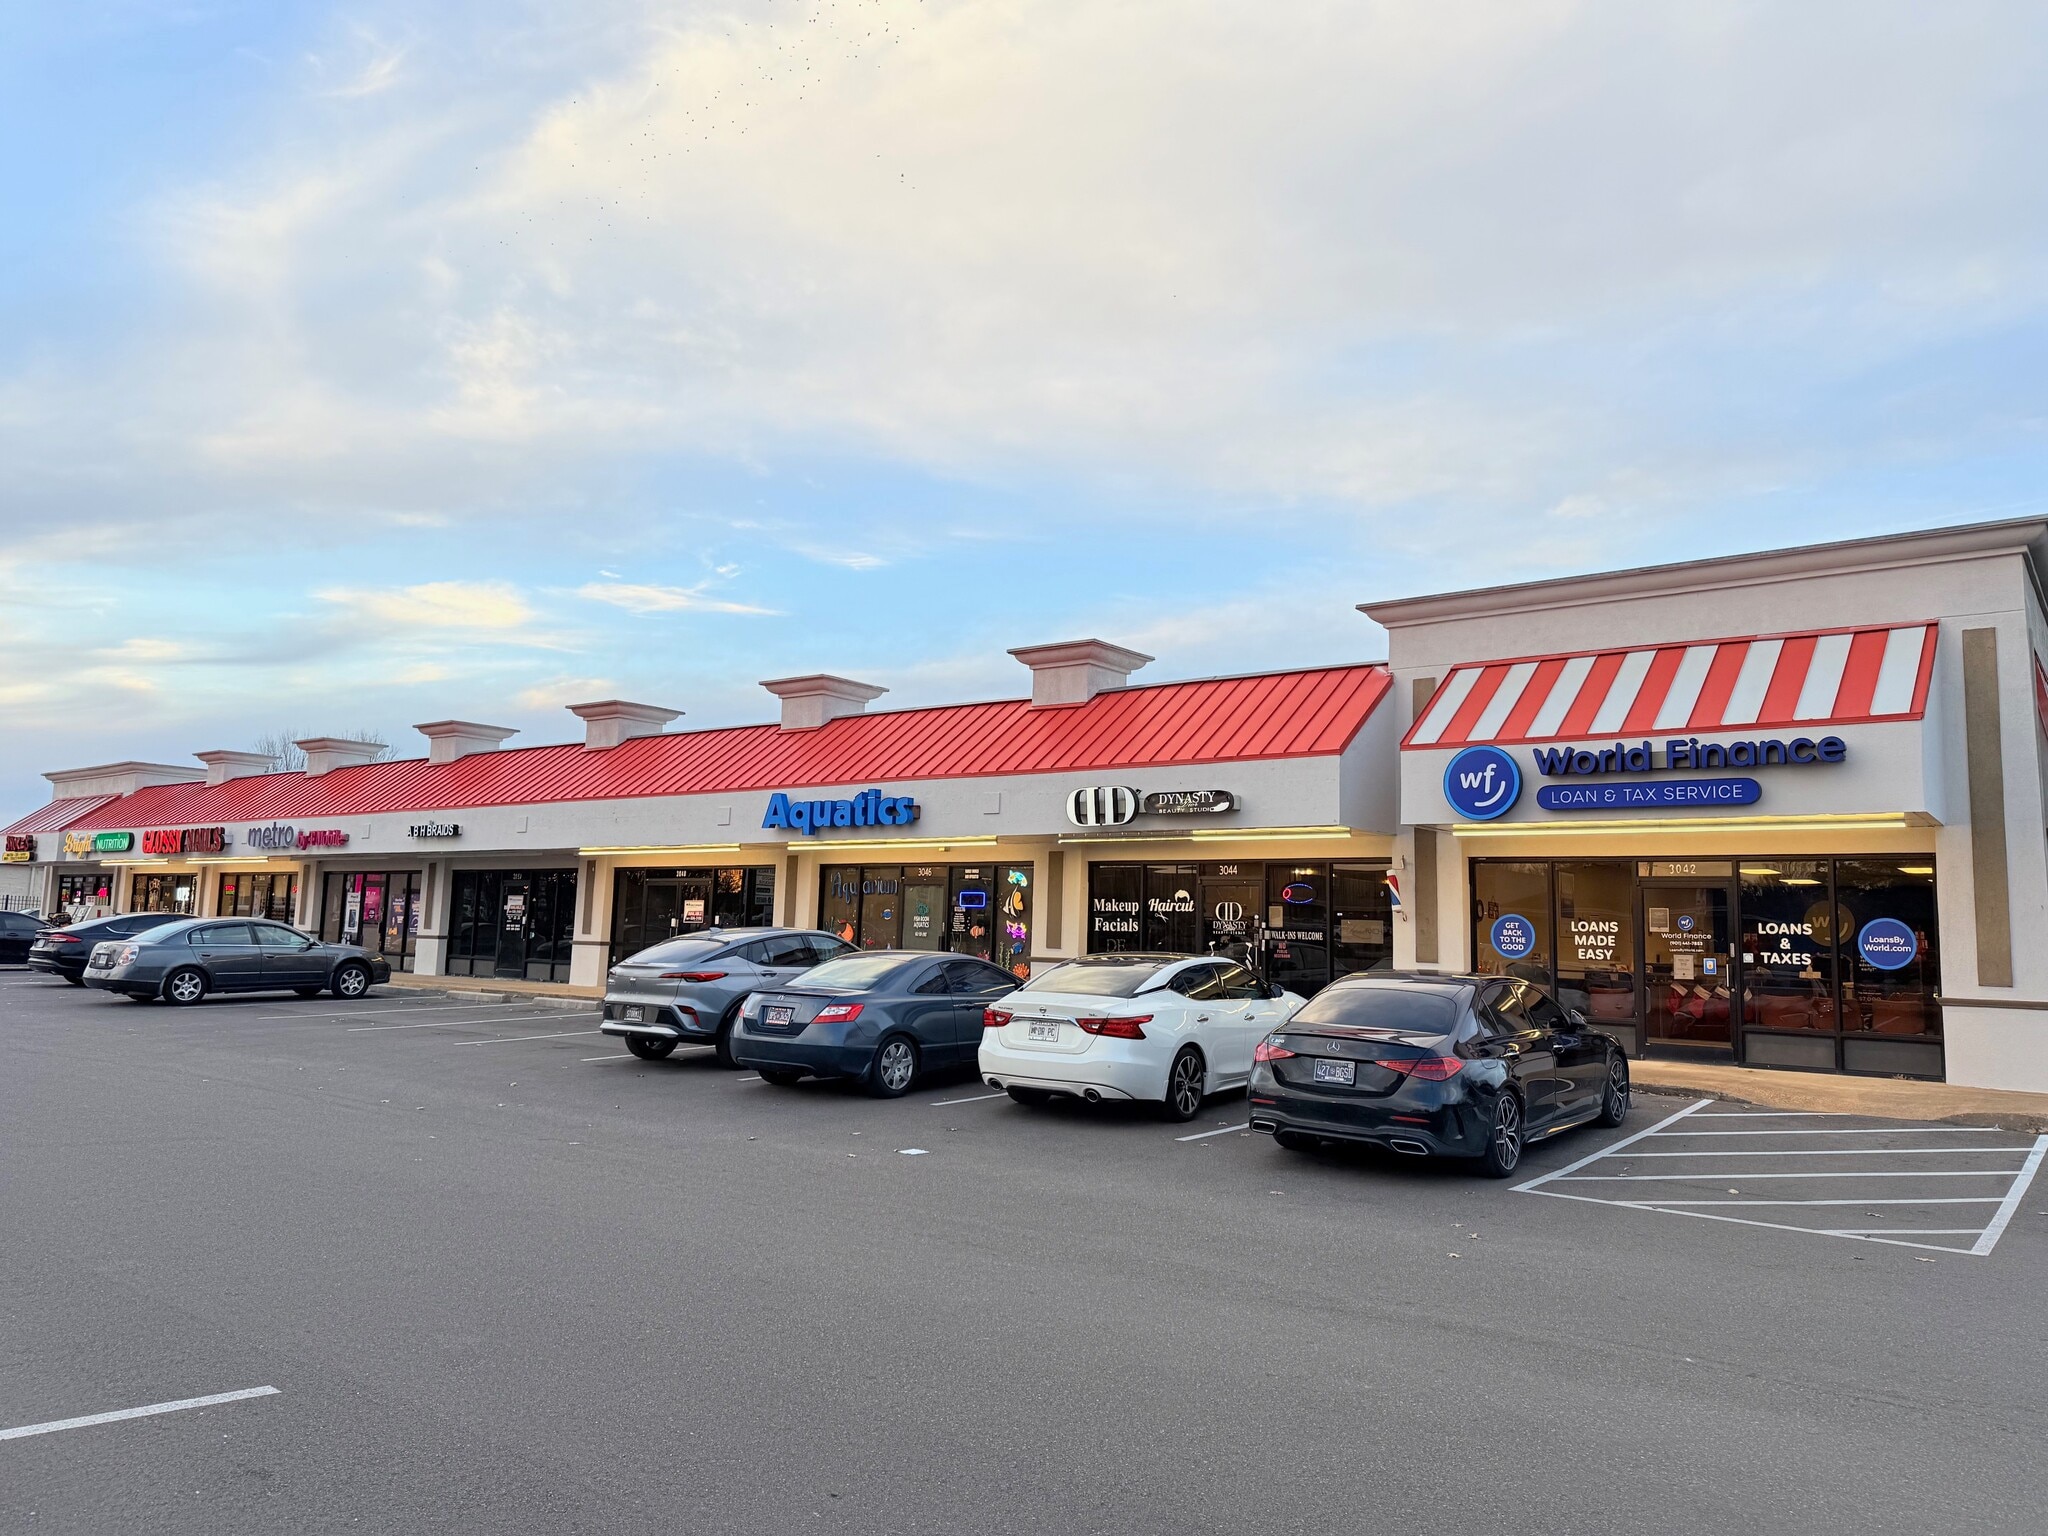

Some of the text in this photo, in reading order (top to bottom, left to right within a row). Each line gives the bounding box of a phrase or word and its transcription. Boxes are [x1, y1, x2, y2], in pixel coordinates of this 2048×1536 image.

[1532, 736, 1847, 776] World Finance
[1158, 791, 1216, 805] DYNASTY
[1551, 784, 1744, 804] LOAN & TAX SERVICE
[762, 789, 915, 836] Aquatics
[1158, 805, 1215, 814] BEAUTY STUDIO
[248, 821, 294, 848] metro
[427, 824, 456, 837] BRAIDS
[63, 832, 92, 859] Bright
[96, 834, 129, 850] NUTRITION
[143, 826, 225, 854] GLOSSY NAILS
[1218, 864, 1238, 875] 3044
[1668, 863, 1697, 875] 3042
[1093, 899, 1139, 915] Makeup
[1148, 898, 1195, 912] Haircut
[1094, 917, 1139, 932] Facials
[1213, 920, 1248, 930] DYNASTY
[1571, 921, 1619, 933] LOANS
[1757, 922, 1813, 935] LOANS
[1271, 930, 1324, 940] WALK-INS WELCOME
[1512, 936, 1527, 944] THE
[1574, 935, 1616, 947] MADE
[1683, 932, 1712, 940] Finance
[1868, 935, 1905, 945] LoansBy
[1502, 943, 1524, 951] GOOD
[1780, 937, 1791, 949] &
[1863, 944, 1912, 952] World.com
[1577, 948, 1614, 960] EASY
[1760, 952, 1812, 965] TAXES
[1316, 1063, 1329, 1076] 427
